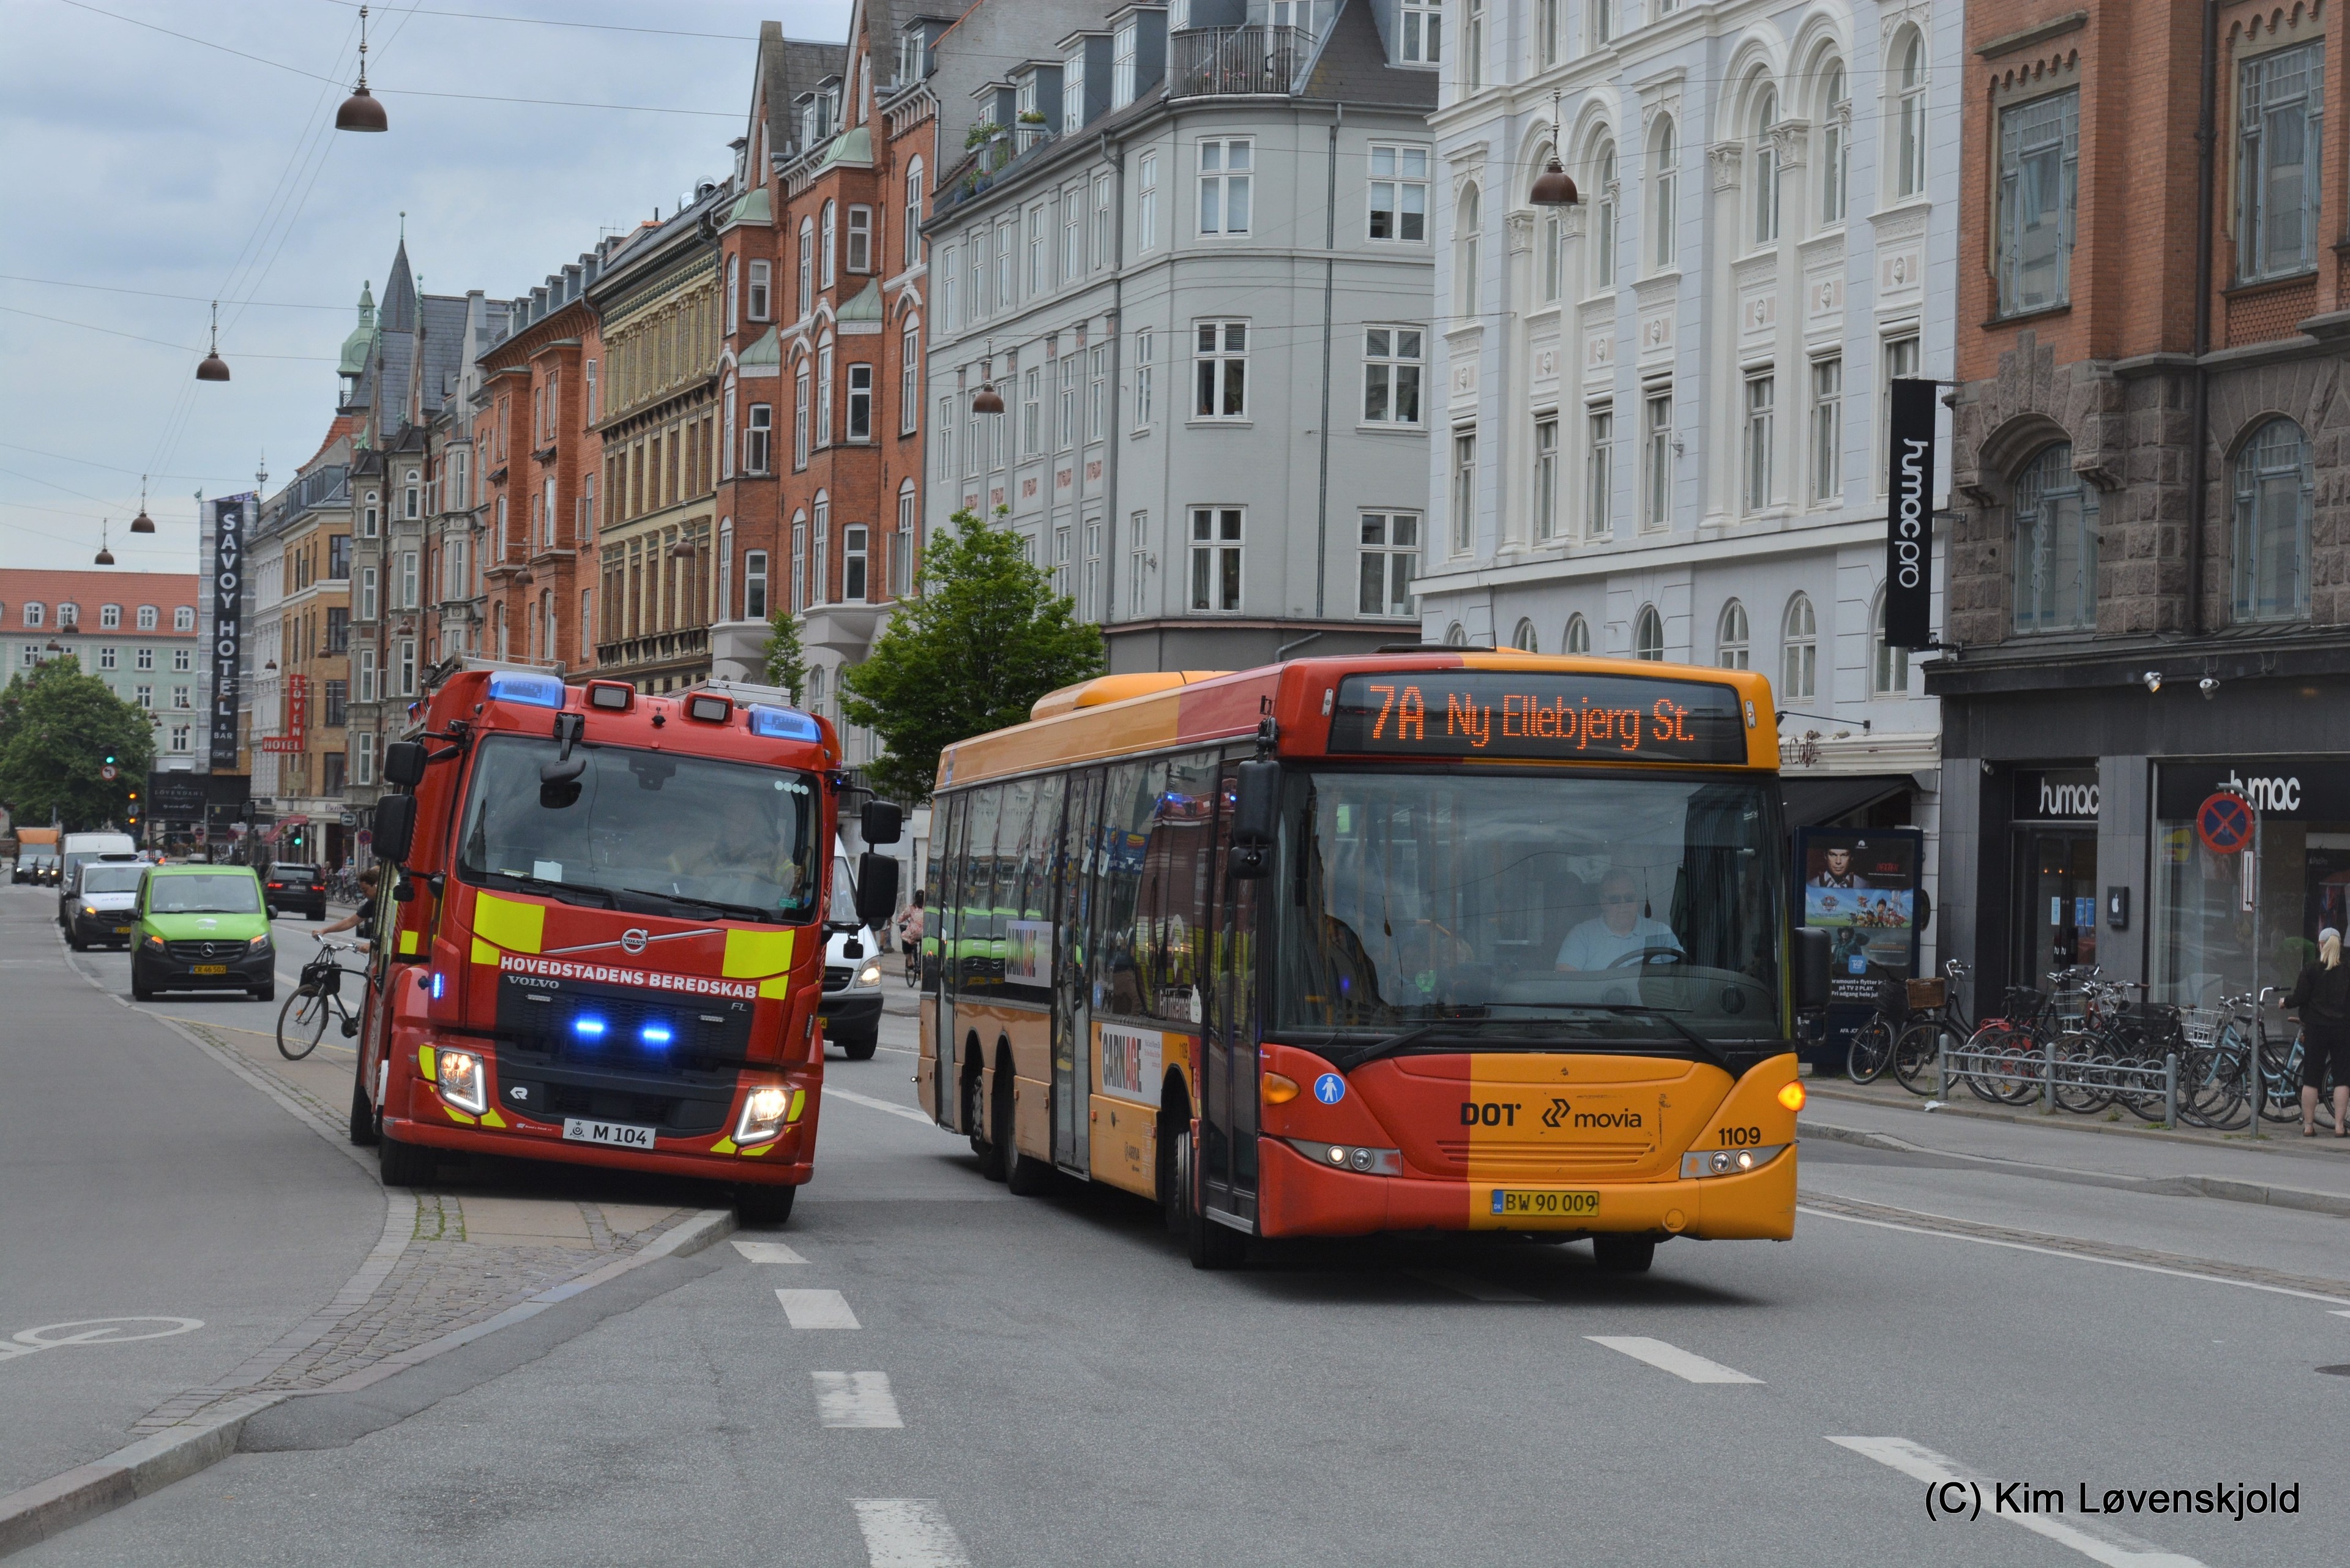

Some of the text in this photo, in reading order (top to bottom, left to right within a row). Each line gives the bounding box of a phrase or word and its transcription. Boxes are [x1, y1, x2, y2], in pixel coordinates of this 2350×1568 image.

[1895, 438, 1928, 588] humac pro
[217, 513, 237, 715] SAVOY HOTEL
[1370, 685, 1694, 751] 7A Ny Ellebjerg St.
[264, 741, 300, 750] HOTEL
[2039, 777, 2099, 815] humac
[1005, 927, 1037, 977] CARNAGE
[501, 955, 756, 999] HOVEDSTADENS BEREDSKAB
[507, 975, 559, 990] VOLVO
[731, 1002, 747, 1012] FL
[1103, 1032, 1142, 1093] CARNAGE
[1460, 1102, 1521, 1126] DOT
[1574, 1108, 1642, 1128] movia
[592, 1124, 647, 1145] M 104
[1718, 1126, 1761, 1146] 1109
[1505, 1193, 1596, 1212] BW 90 009
